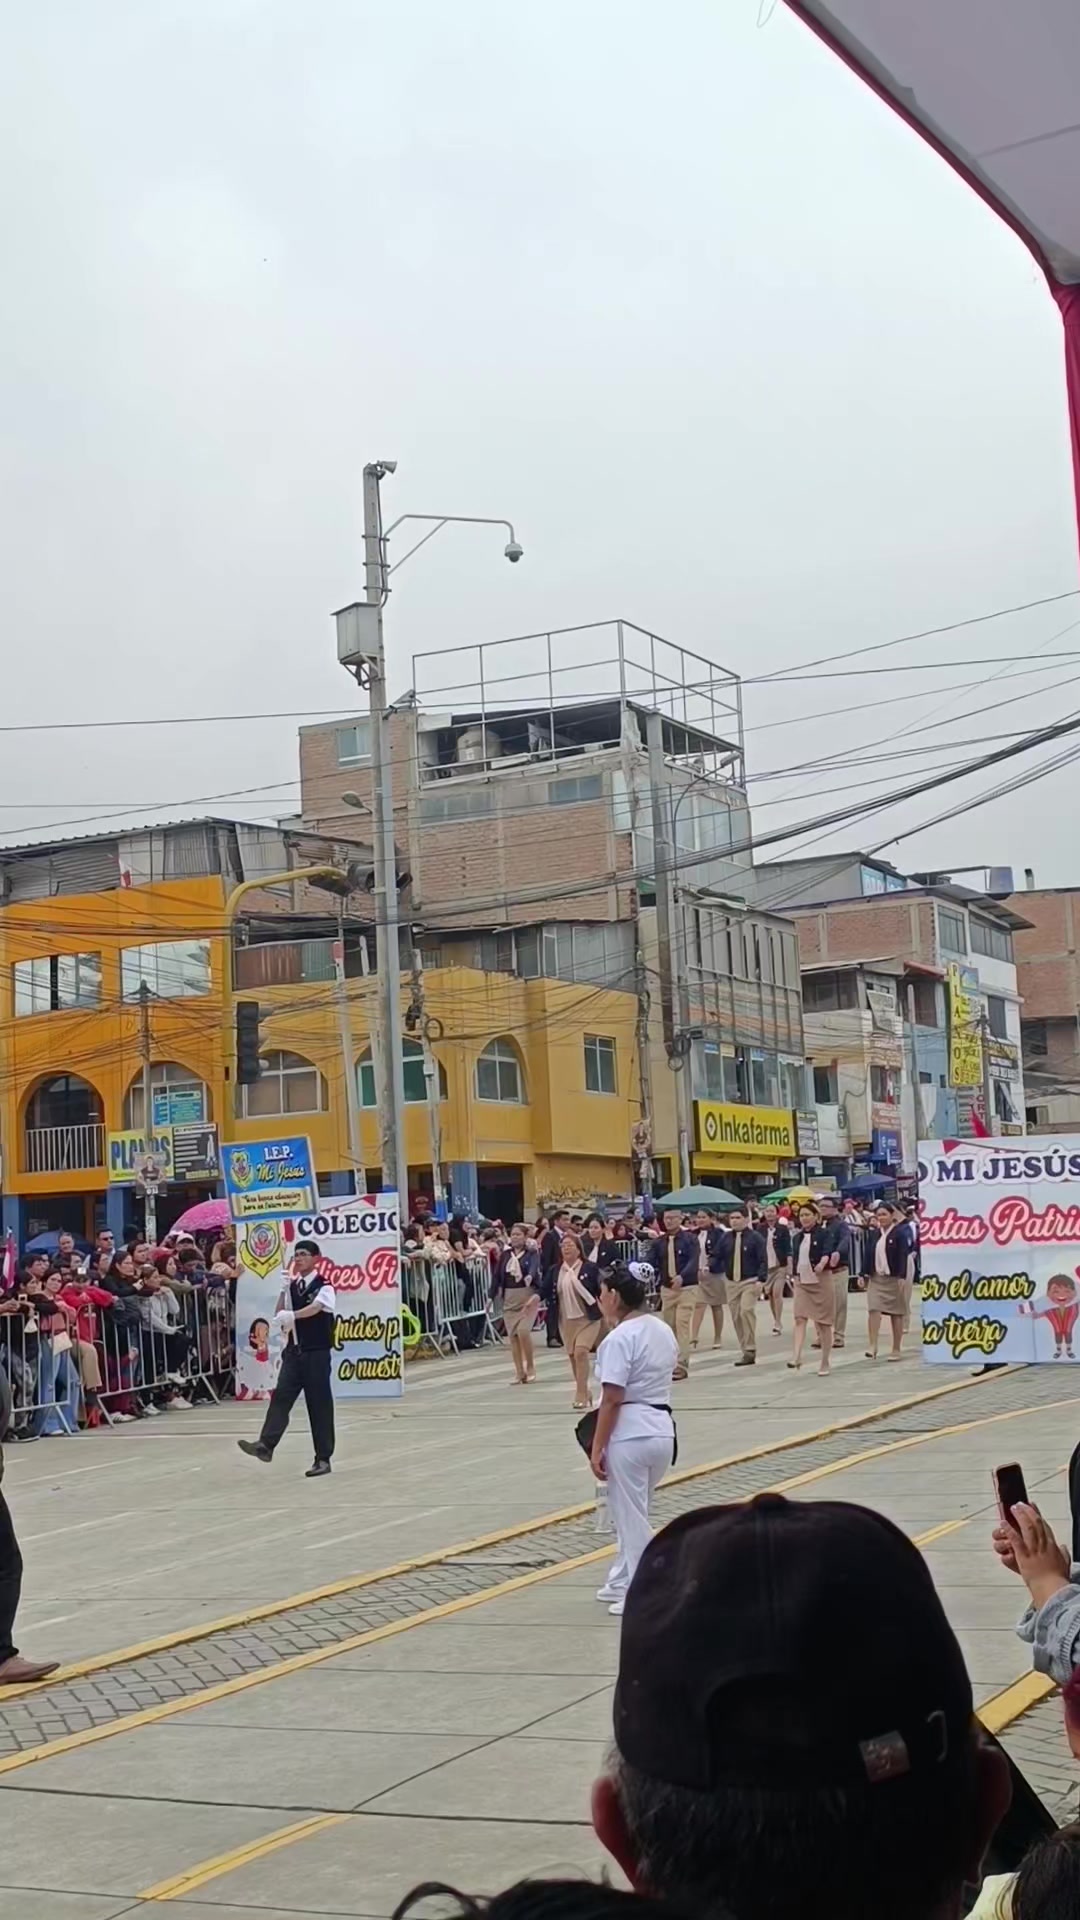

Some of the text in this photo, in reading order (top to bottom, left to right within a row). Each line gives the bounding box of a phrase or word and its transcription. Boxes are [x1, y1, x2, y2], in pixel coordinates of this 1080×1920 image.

[719, 1112, 790, 1146] Inkafarma
[936, 1159, 975, 1182] MI
[947, 1269, 973, 1301] el
[974, 1272, 1036, 1300] amor
[943, 1312, 1008, 1359] tierra
[338, 1359, 355, 1380] a
